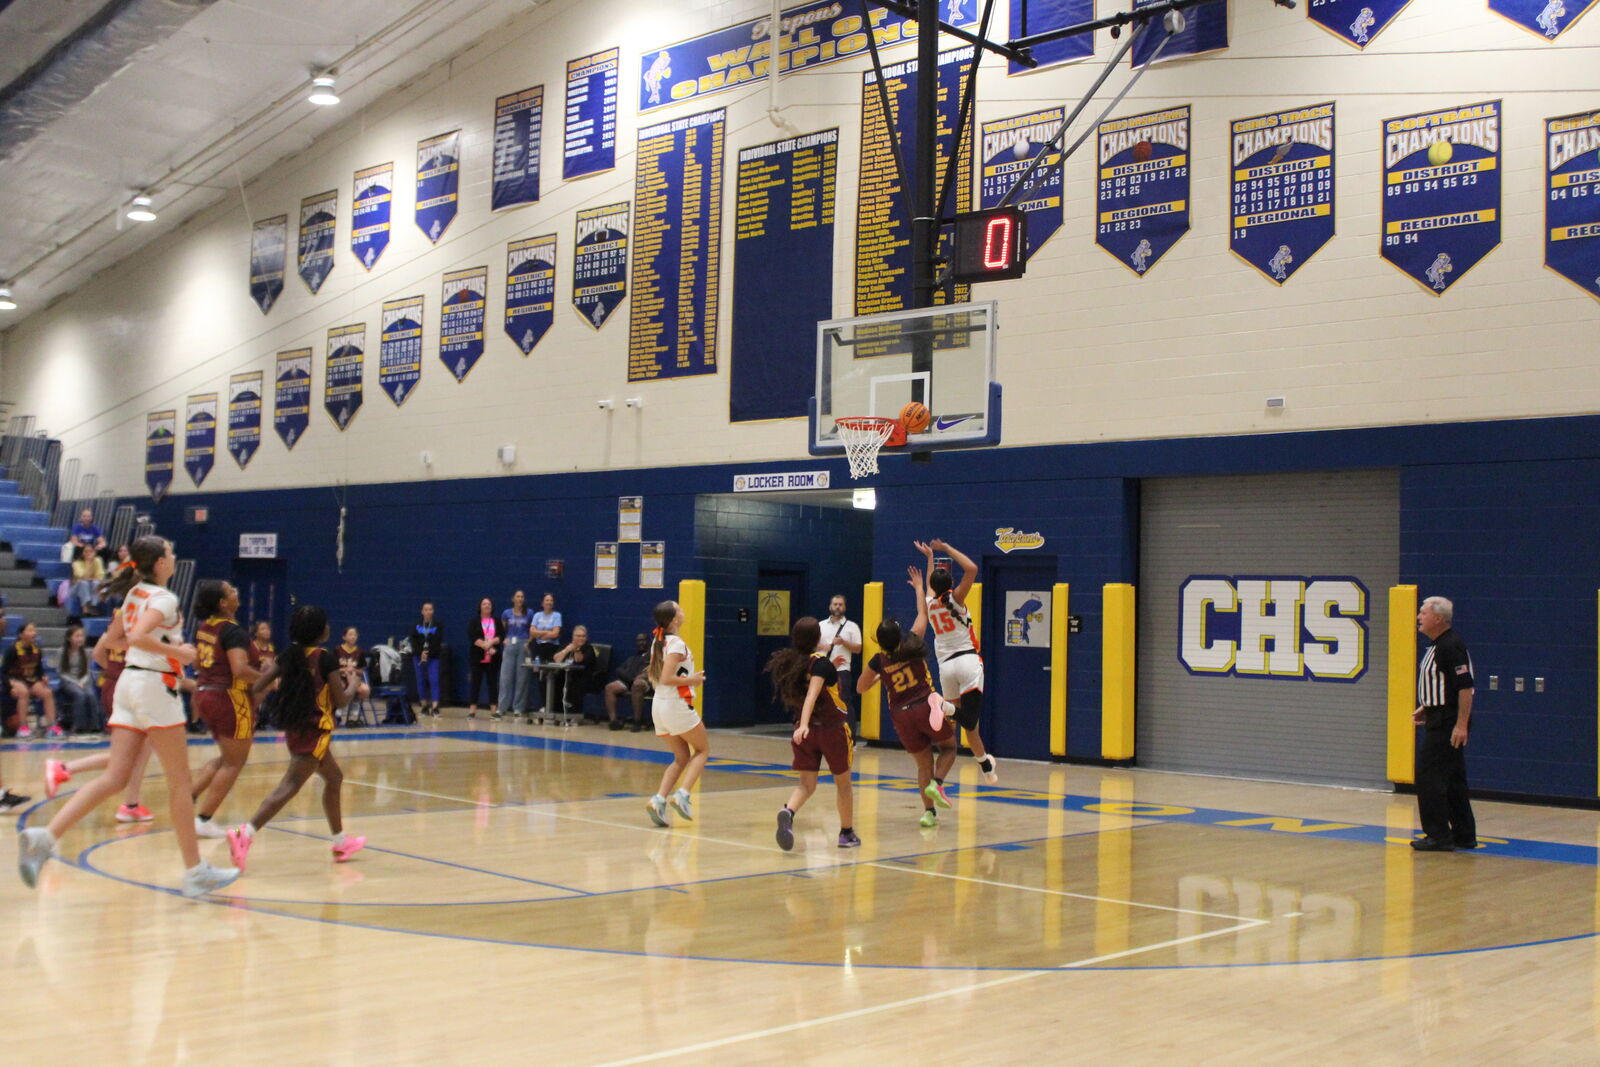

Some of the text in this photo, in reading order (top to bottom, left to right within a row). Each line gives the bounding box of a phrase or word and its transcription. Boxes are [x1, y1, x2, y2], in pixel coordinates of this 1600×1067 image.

[752, 2, 842, 40] Trpons
[706, 7, 888, 72] WALL OF
[670, 19, 919, 100] CHAMPIONS
[1233, 104, 1333, 133] GIRLS TRACK
[1387, 104, 1497, 133] SOFTBALL
[740, 130, 837, 162] INDIVIDUAL STATE CHAMPIONS
[1100, 119, 1188, 166] CHAMPIONS
[1234, 117, 1332, 167] CHAMPIONS
[1386, 117, 1497, 169] CHAMPIONS
[1101, 167, 1186, 190] 95 02 03 19 21 22
[1113, 159, 1174, 177] DISTRICT
[1249, 160, 1317, 178] DISTRICT
[1402, 162, 1480, 181] DISTRICT
[984, 177, 994, 187] 91
[996, 175, 1007, 185] 95
[984, 187, 994, 197] 16
[996, 185, 1006, 195] 21
[1050, 176, 1060, 186] 25
[1235, 168, 1330, 192] 82 94 95 96 00 03
[1387, 175, 1477, 196] 89 90 94 95 23
[1101, 185, 1140, 200] 23 24 25
[1235, 180, 1330, 204] 04 05 06 07 08 09
[1235, 191, 1330, 215] 12 13 17 18 19 21
[1551, 185, 1588, 200] 04 05
[1112, 204, 1173, 220] REGIONAL
[1247, 207, 1317, 225] REGIONAL
[1400, 213, 1480, 231] REGIONAL
[577, 212, 628, 245] CHAMPIONS
[1100, 220, 1141, 234] 21 22 23
[1234, 229, 1247, 240] 19
[584, 241, 618, 254] DISTRICT
[983, 217, 1010, 269] 0
[1386, 233, 1418, 246] 90 94
[581, 284, 617, 295] REGIONAL
[748, 474, 814, 488] LOCKER ROOM
[930, 611, 956, 634] 15
[1178, 575, 1370, 684] CHS
[891, 666, 918, 693] 21
